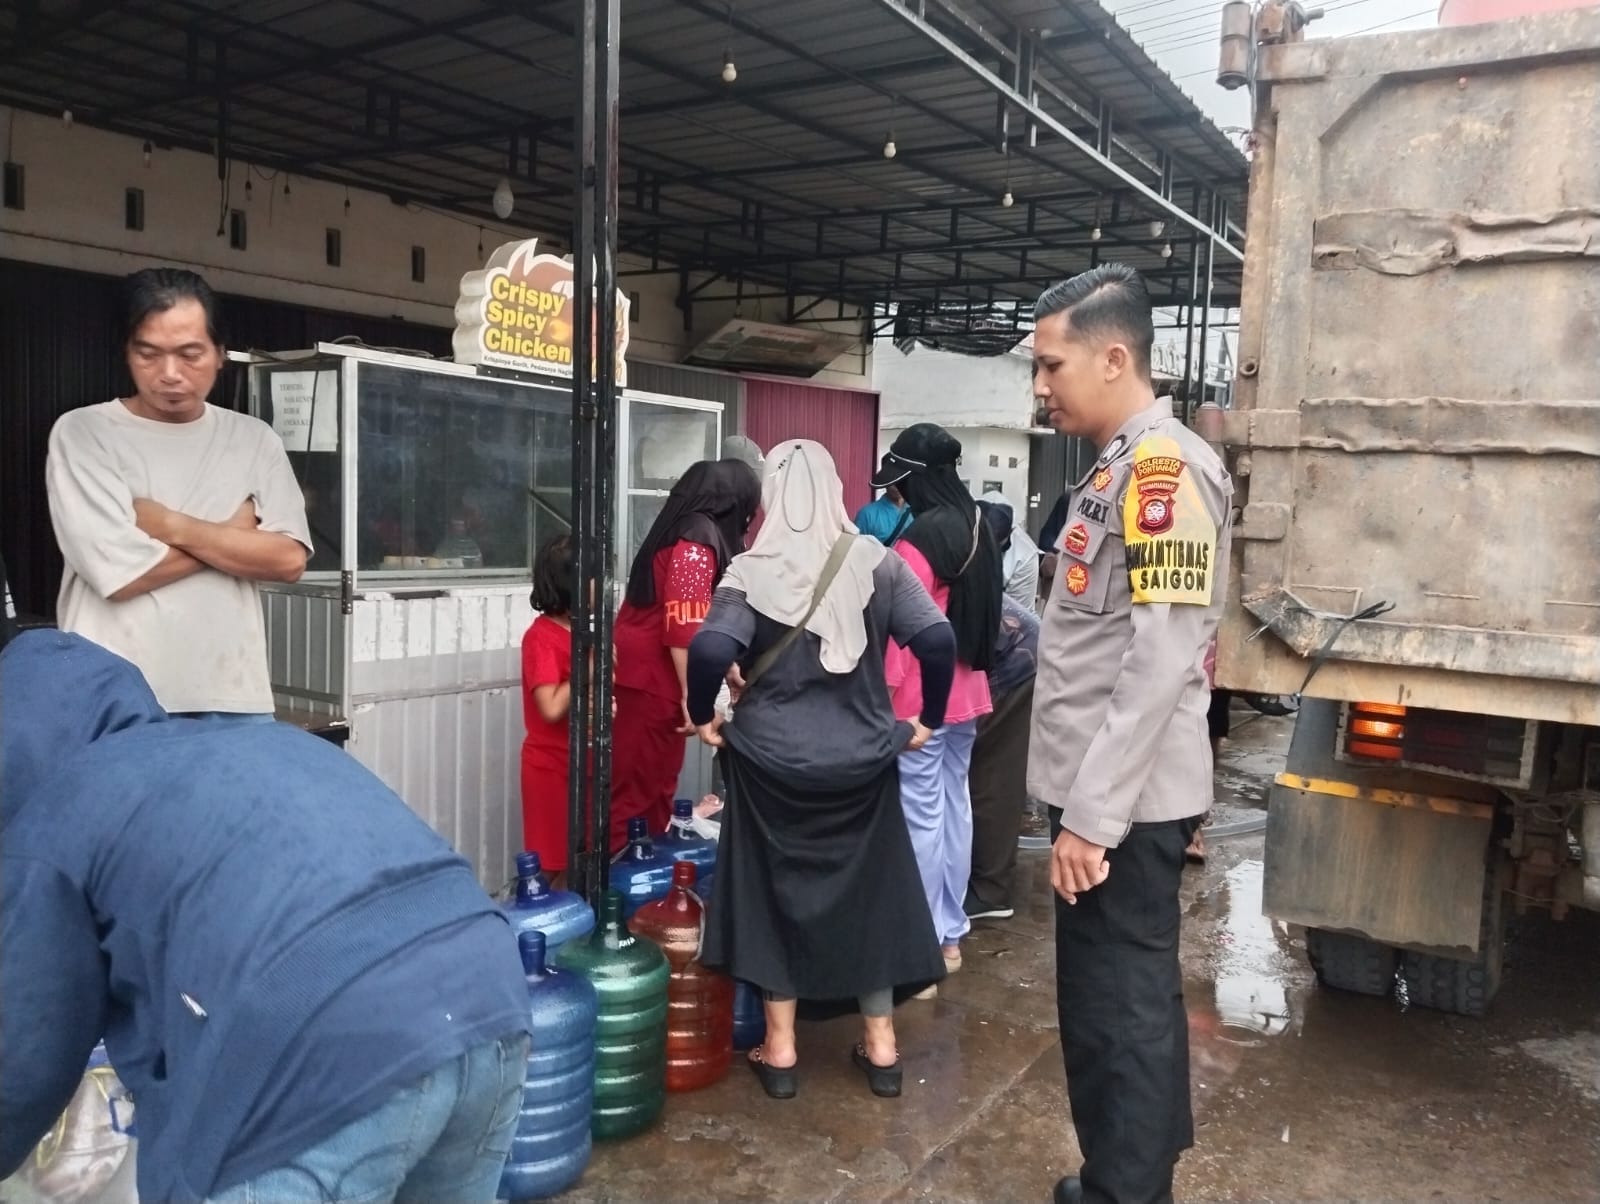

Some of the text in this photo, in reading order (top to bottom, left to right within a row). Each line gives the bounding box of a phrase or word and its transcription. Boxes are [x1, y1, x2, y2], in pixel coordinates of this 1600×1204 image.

[491, 276, 566, 317] Crispy
[486, 300, 548, 336] Spicy
[484, 327, 571, 364] Chicken
[1136, 458, 1180, 470] POLRESTA
[1138, 463, 1178, 475] PONTIANAK
[1077, 497, 1109, 524] POLRI
[1140, 569, 1206, 592] SAIGON
